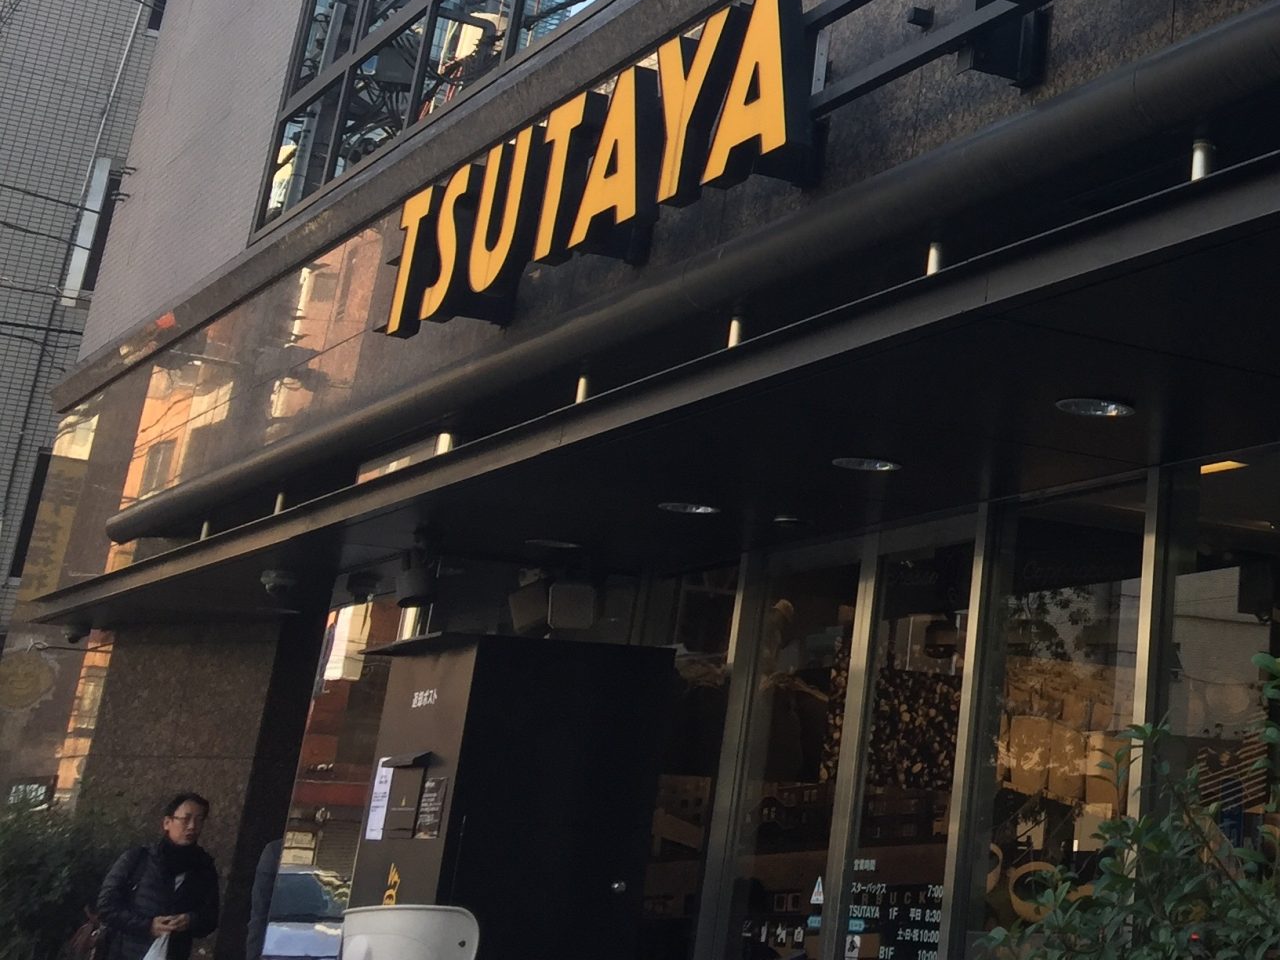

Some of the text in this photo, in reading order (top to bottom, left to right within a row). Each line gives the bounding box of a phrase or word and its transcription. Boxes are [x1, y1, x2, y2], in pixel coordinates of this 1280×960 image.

[849, 904, 880, 919] TSUTAYA
[889, 907, 899, 920] 1F
[925, 909, 941, 923] 8:30
